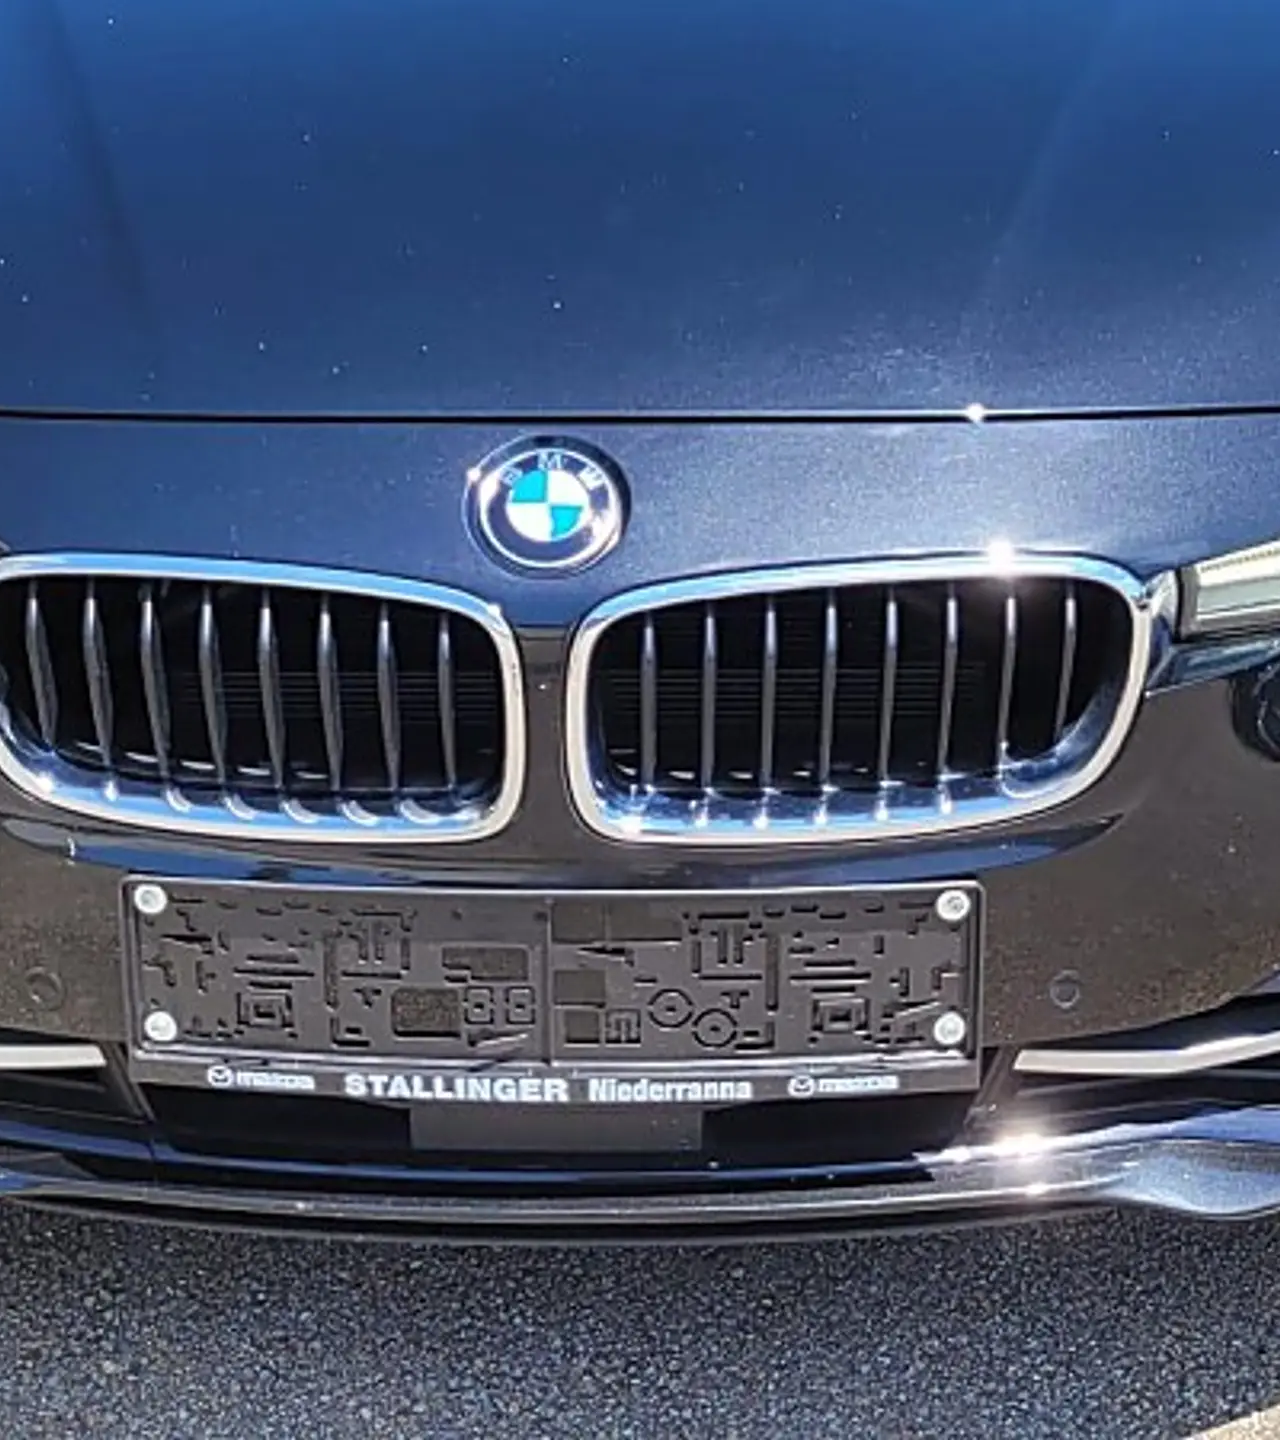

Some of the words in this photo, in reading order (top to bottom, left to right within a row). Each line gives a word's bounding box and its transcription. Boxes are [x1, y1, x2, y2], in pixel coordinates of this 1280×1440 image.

[499, 449, 607, 491] BMW
[344, 1072, 570, 1103] STALLINGER
[587, 1077, 753, 1103] Niederranna
